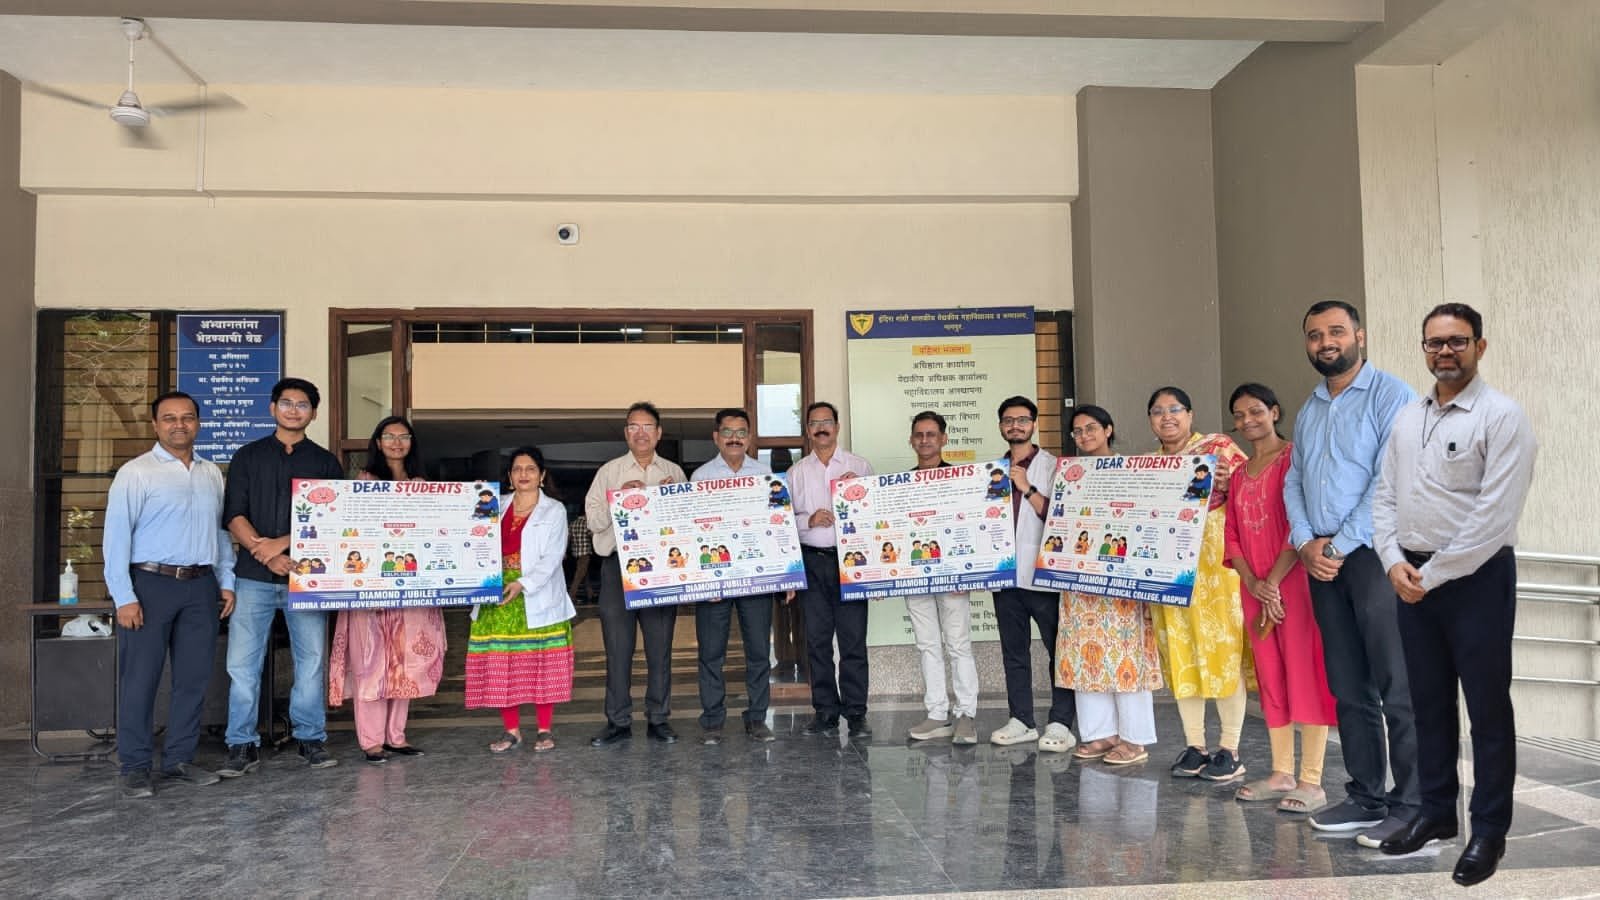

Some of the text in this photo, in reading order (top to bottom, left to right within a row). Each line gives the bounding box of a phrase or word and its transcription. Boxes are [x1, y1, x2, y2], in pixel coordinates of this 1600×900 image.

[200, 318, 259, 329] अभ्यागतांना
[196, 332, 263, 343] भेटण्याची वेळ
[1096, 457, 1183, 470] DEAR STUDENTS
[879, 465, 975, 487] DEAR STUDENTS
[353, 481, 463, 494] DEAR STUDENTS
[660, 477, 754, 497] DEAR STUDENTS
[685, 578, 752, 593] DIAMOND JUBILEE
[895, 575, 959, 588] DIAMOND JUBILEE
[1078, 574, 1137, 589] DIAMOND JUBILEE
[359, 589, 438, 600] DIAMOND JUBILEE
[1106, 587, 1132, 598] MEDICAL
[292, 601, 318, 609] INDIRA
[320, 601, 349, 609] GANDHI
[350, 599, 401, 608] GOVERNMENT
[402, 598, 434, 607] MEDICAL
[471, 595, 499, 604] NAGPUR
